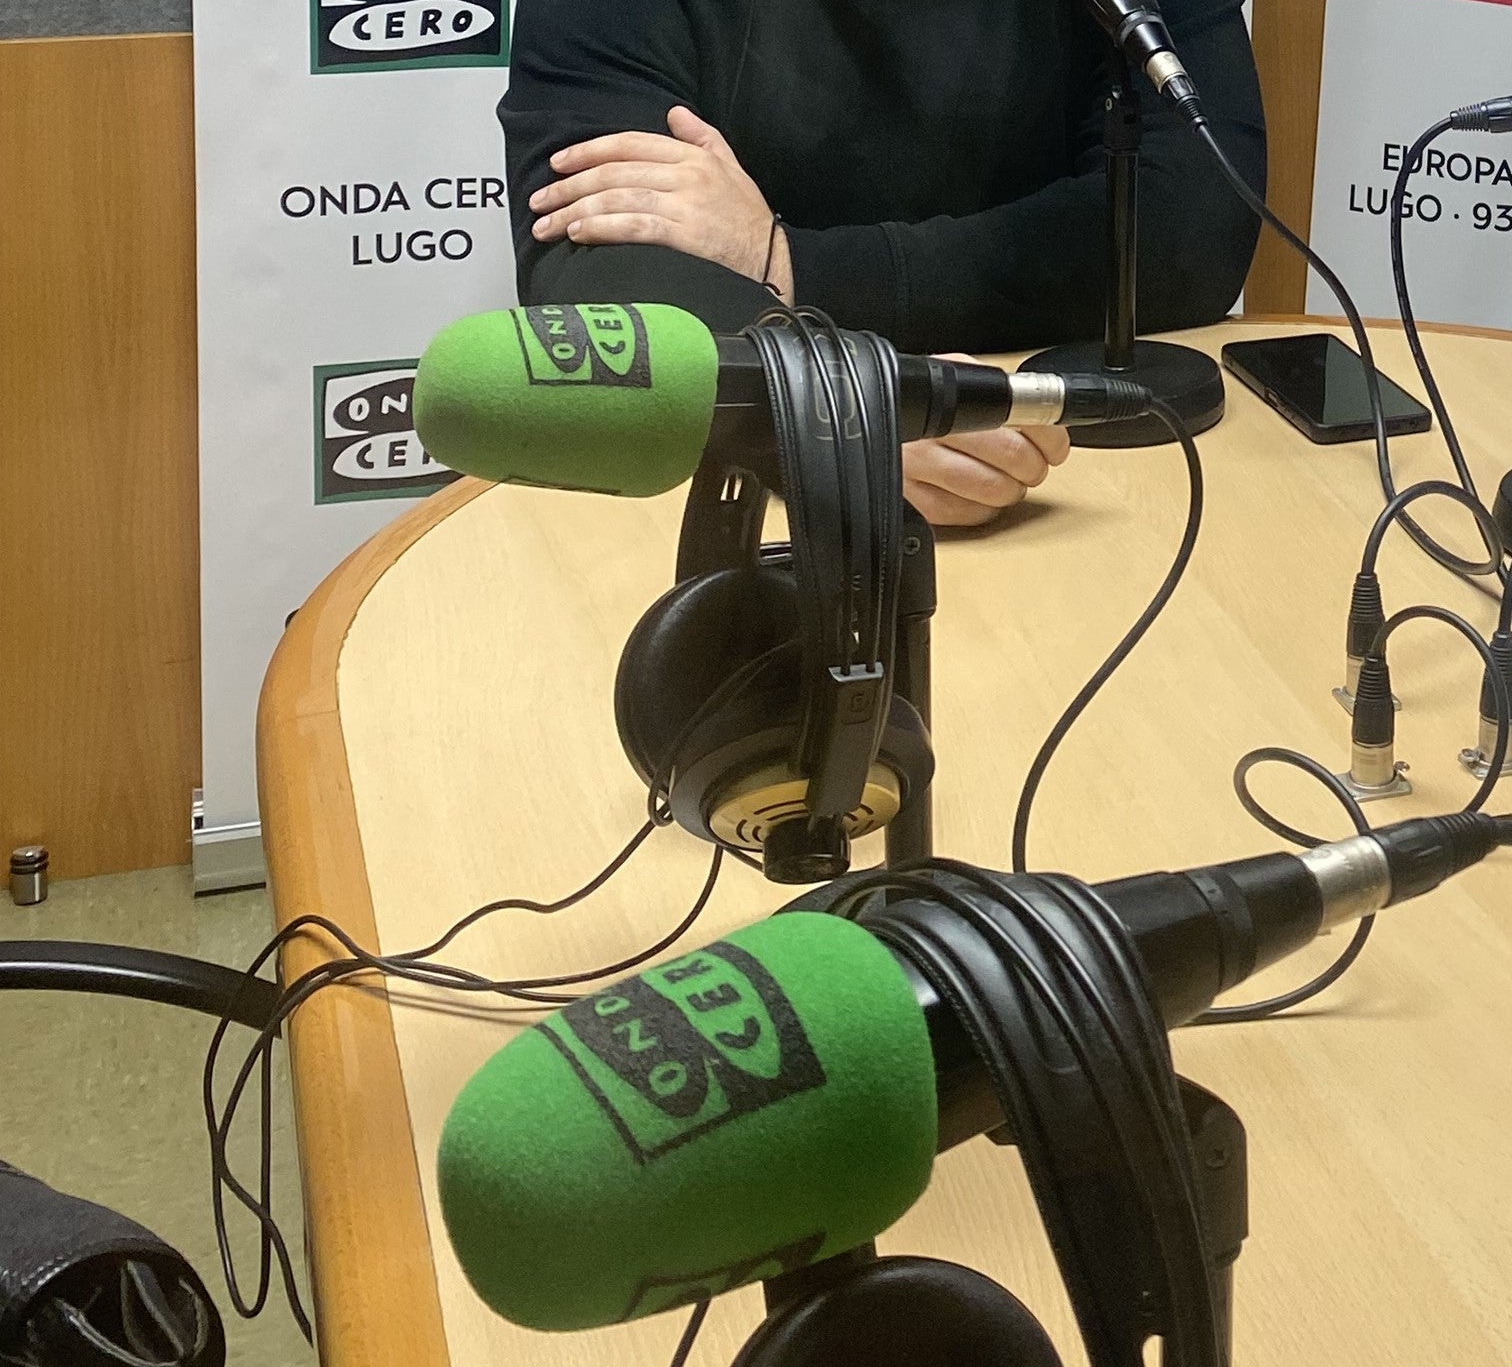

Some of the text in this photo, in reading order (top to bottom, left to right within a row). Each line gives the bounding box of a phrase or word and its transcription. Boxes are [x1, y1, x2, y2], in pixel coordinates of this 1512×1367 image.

[352, 8, 473, 41] CERO
[280, 177, 505, 218] ONDA CER
[1348, 183, 1443, 223] LUGO
[352, 229, 473, 266] LUGO
[541, 306, 576, 361] OND
[588, 306, 626, 355] CER
[348, 392, 408, 422] ON
[355, 439, 431, 470] CE
[662, 959, 761, 1050] CER
[594, 994, 688, 1097] OND
